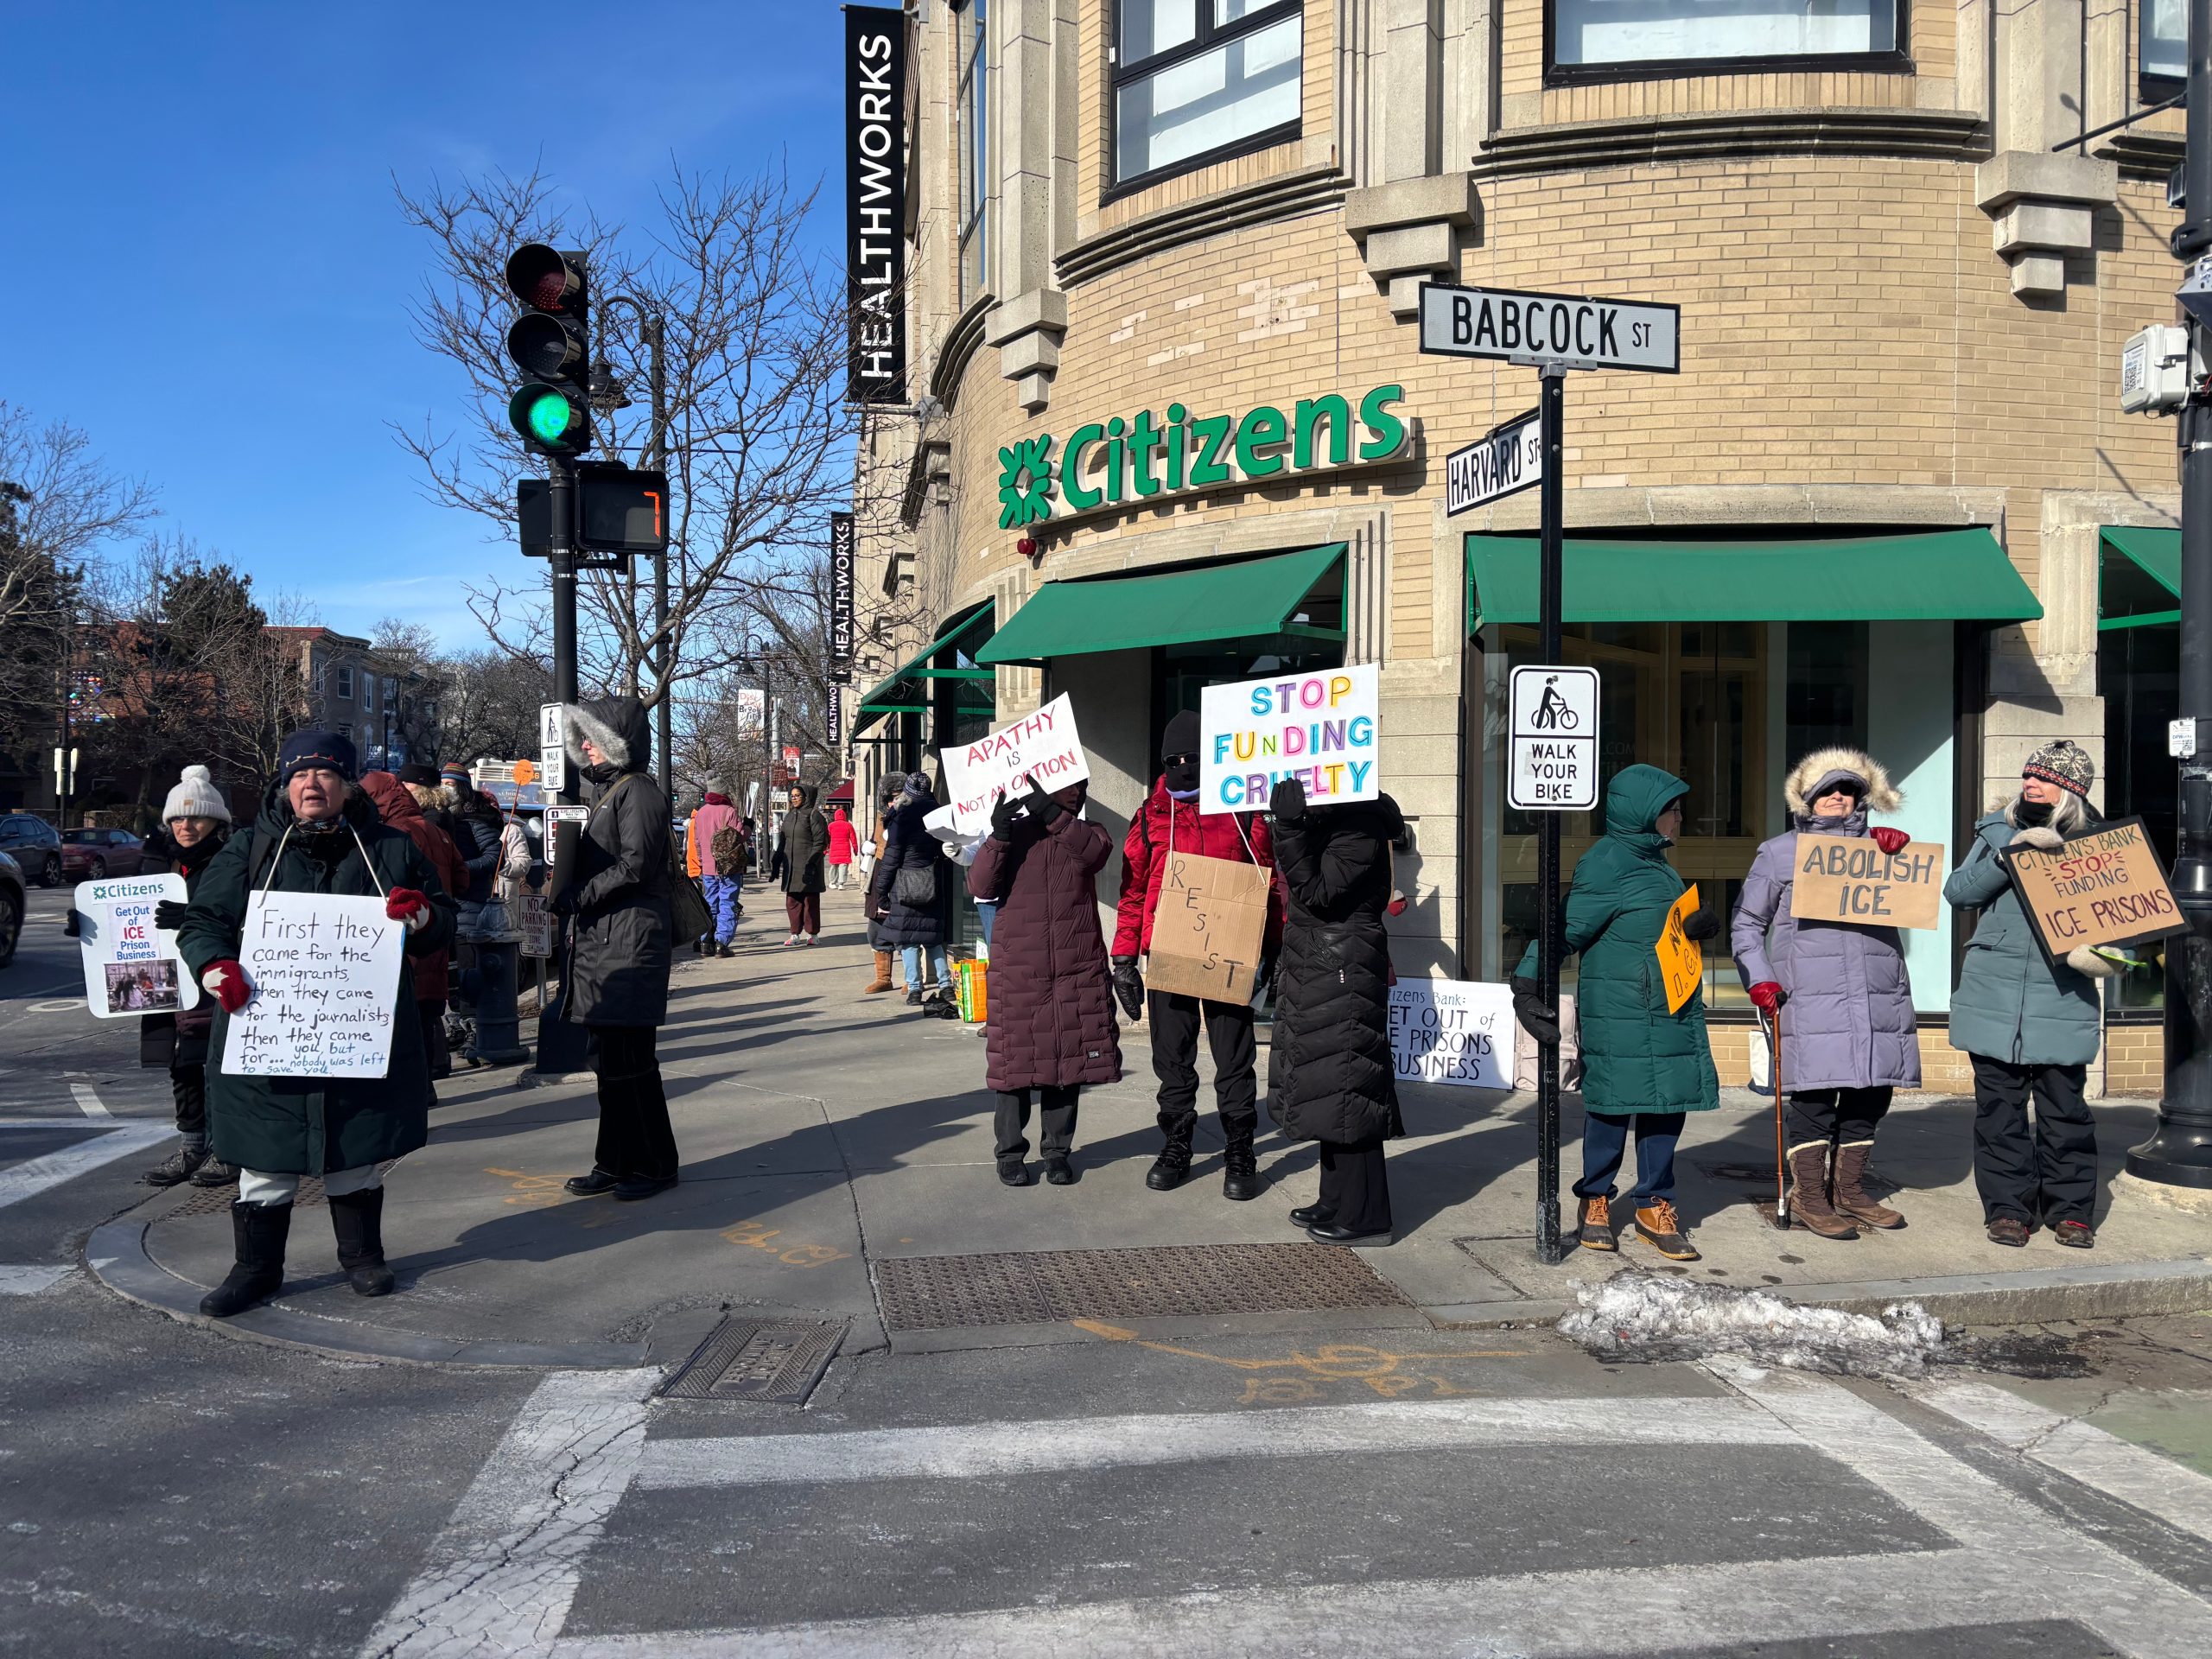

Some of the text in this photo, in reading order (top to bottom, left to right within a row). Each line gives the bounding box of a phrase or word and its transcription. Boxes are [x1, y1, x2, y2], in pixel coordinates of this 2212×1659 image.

[859, 34, 893, 378] HEALTHWORKS
[1452, 295, 1652, 358] BABCOCK ST
[1061, 384, 1405, 510] Citizens
[1451, 434, 1522, 507] HARVARD
[836, 522, 850, 657] HEALTHWORKS
[1251, 677, 1353, 716] STOP
[968, 704, 1056, 767] APATHY
[1214, 715, 1373, 765] FUNDING
[546, 751, 558, 760] WALK
[1007, 751, 1021, 768] IS
[1531, 744, 1577, 760] WALK
[546, 763, 559, 773] YOUR
[1531, 764, 1577, 779] YOUR
[548, 775, 558, 785] BIKE
[957, 794, 986, 815] NOT
[1012, 747, 1078, 791] OPTION
[1535, 785, 1573, 799] BIKE
[2018, 827, 2142, 871] CITIZEN'S BANK
[1802, 845, 1935, 884] ABOLISH
[2060, 853, 2113, 880] STOP
[108, 883, 164, 898] Citizens
[2054, 868, 2129, 899] FUNDING
[116, 906, 150, 917] Get Out
[527, 898, 539, 912] NO
[2045, 889, 2174, 938] ICE PRISONS
[128, 916, 137, 926] of
[262, 909, 385, 949] First they
[521, 912, 546, 926] PARKING
[124, 926, 144, 939] ICE
[525, 925, 544, 935] LOADING
[529, 935, 541, 944] ZONE
[1669, 906, 1682, 957] NO
[120, 940, 150, 950] Prison
[252, 944, 372, 963] came for the
[117, 950, 156, 961] Business
[255, 965, 350, 987] immigrants,
[249, 981, 374, 1006] then they came
[1388, 989, 1466, 1006] tizens Bank:
[246, 1000, 268, 1022] for
[276, 1004, 305, 1024] the
[1389, 1005, 1497, 1031] ET OUT of
[240, 1026, 372, 1047] then they came
[1410, 1029, 1493, 1055] PRISONS
[329, 1043, 356, 1054] but
[242, 1064, 255, 1073] to
[263, 1065, 293, 1074] save
[289, 1052, 386, 1069] nobody was left
